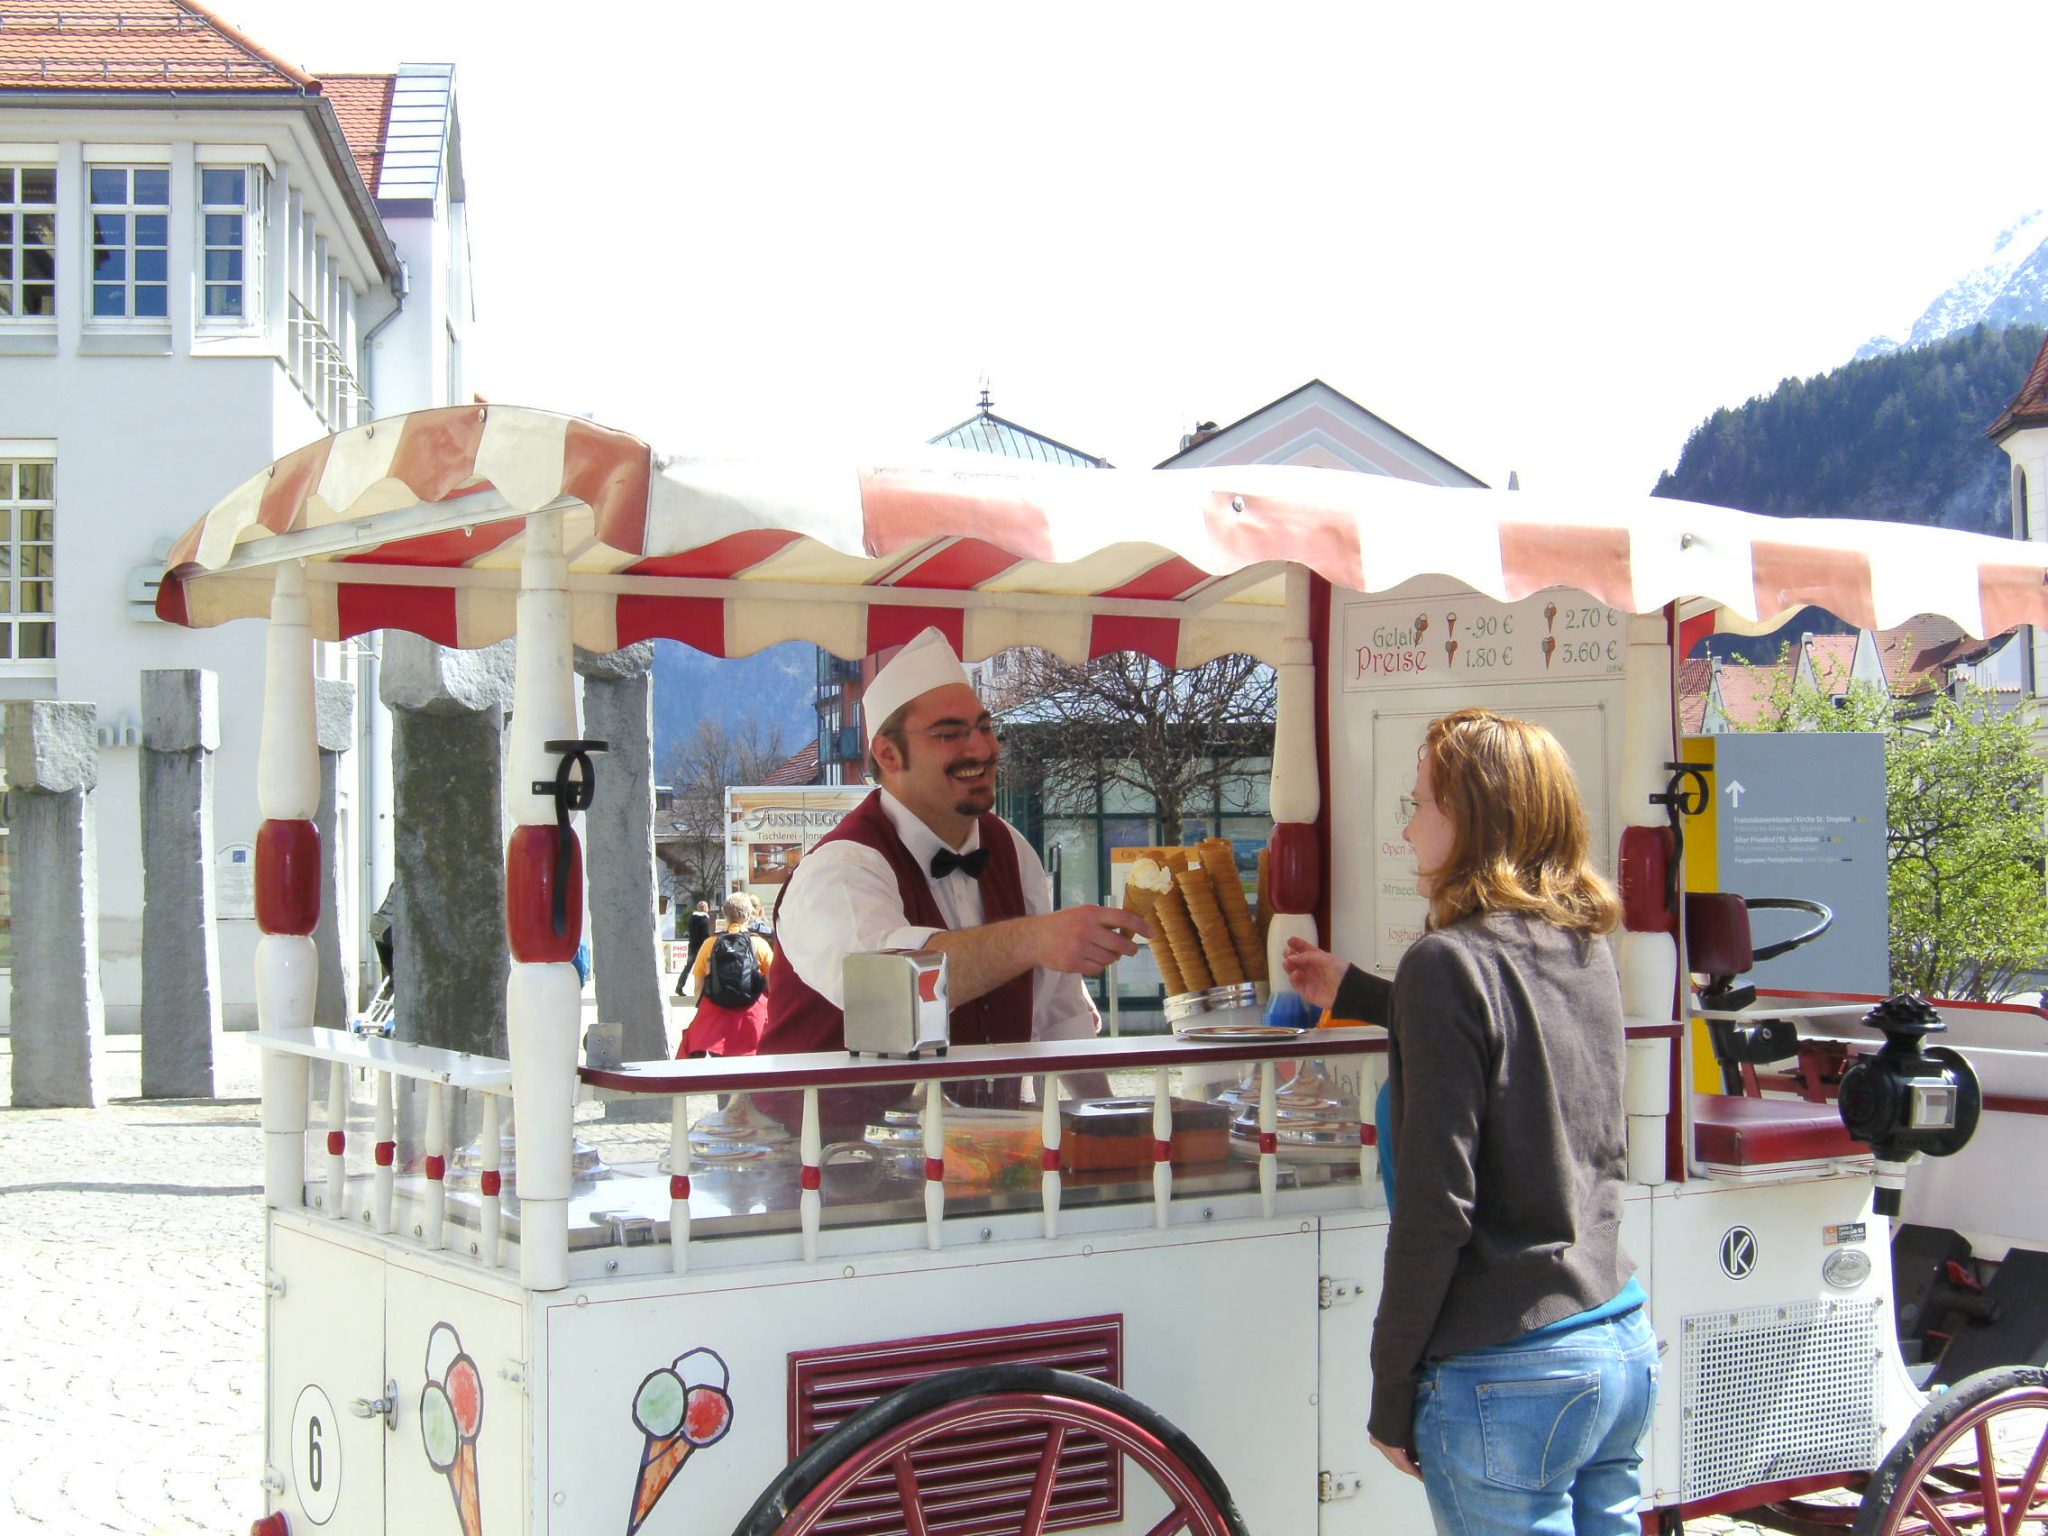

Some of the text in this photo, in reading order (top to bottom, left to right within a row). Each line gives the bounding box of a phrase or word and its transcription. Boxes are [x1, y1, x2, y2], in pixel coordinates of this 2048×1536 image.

[1465, 614, 1513, 638] -.90 €
[1566, 608, 1618, 629] 2.70 €
[1373, 626, 1424, 647] Gelato
[1356, 646, 1428, 680] Preise
[1466, 646, 1513, 668] 1.80 €
[1562, 640, 1618, 663] 3.60 €
[744, 807, 849, 831] FUSSENEGG
[757, 832, 797, 841] Tischlerei
[309, 1415, 322, 1492] 6
